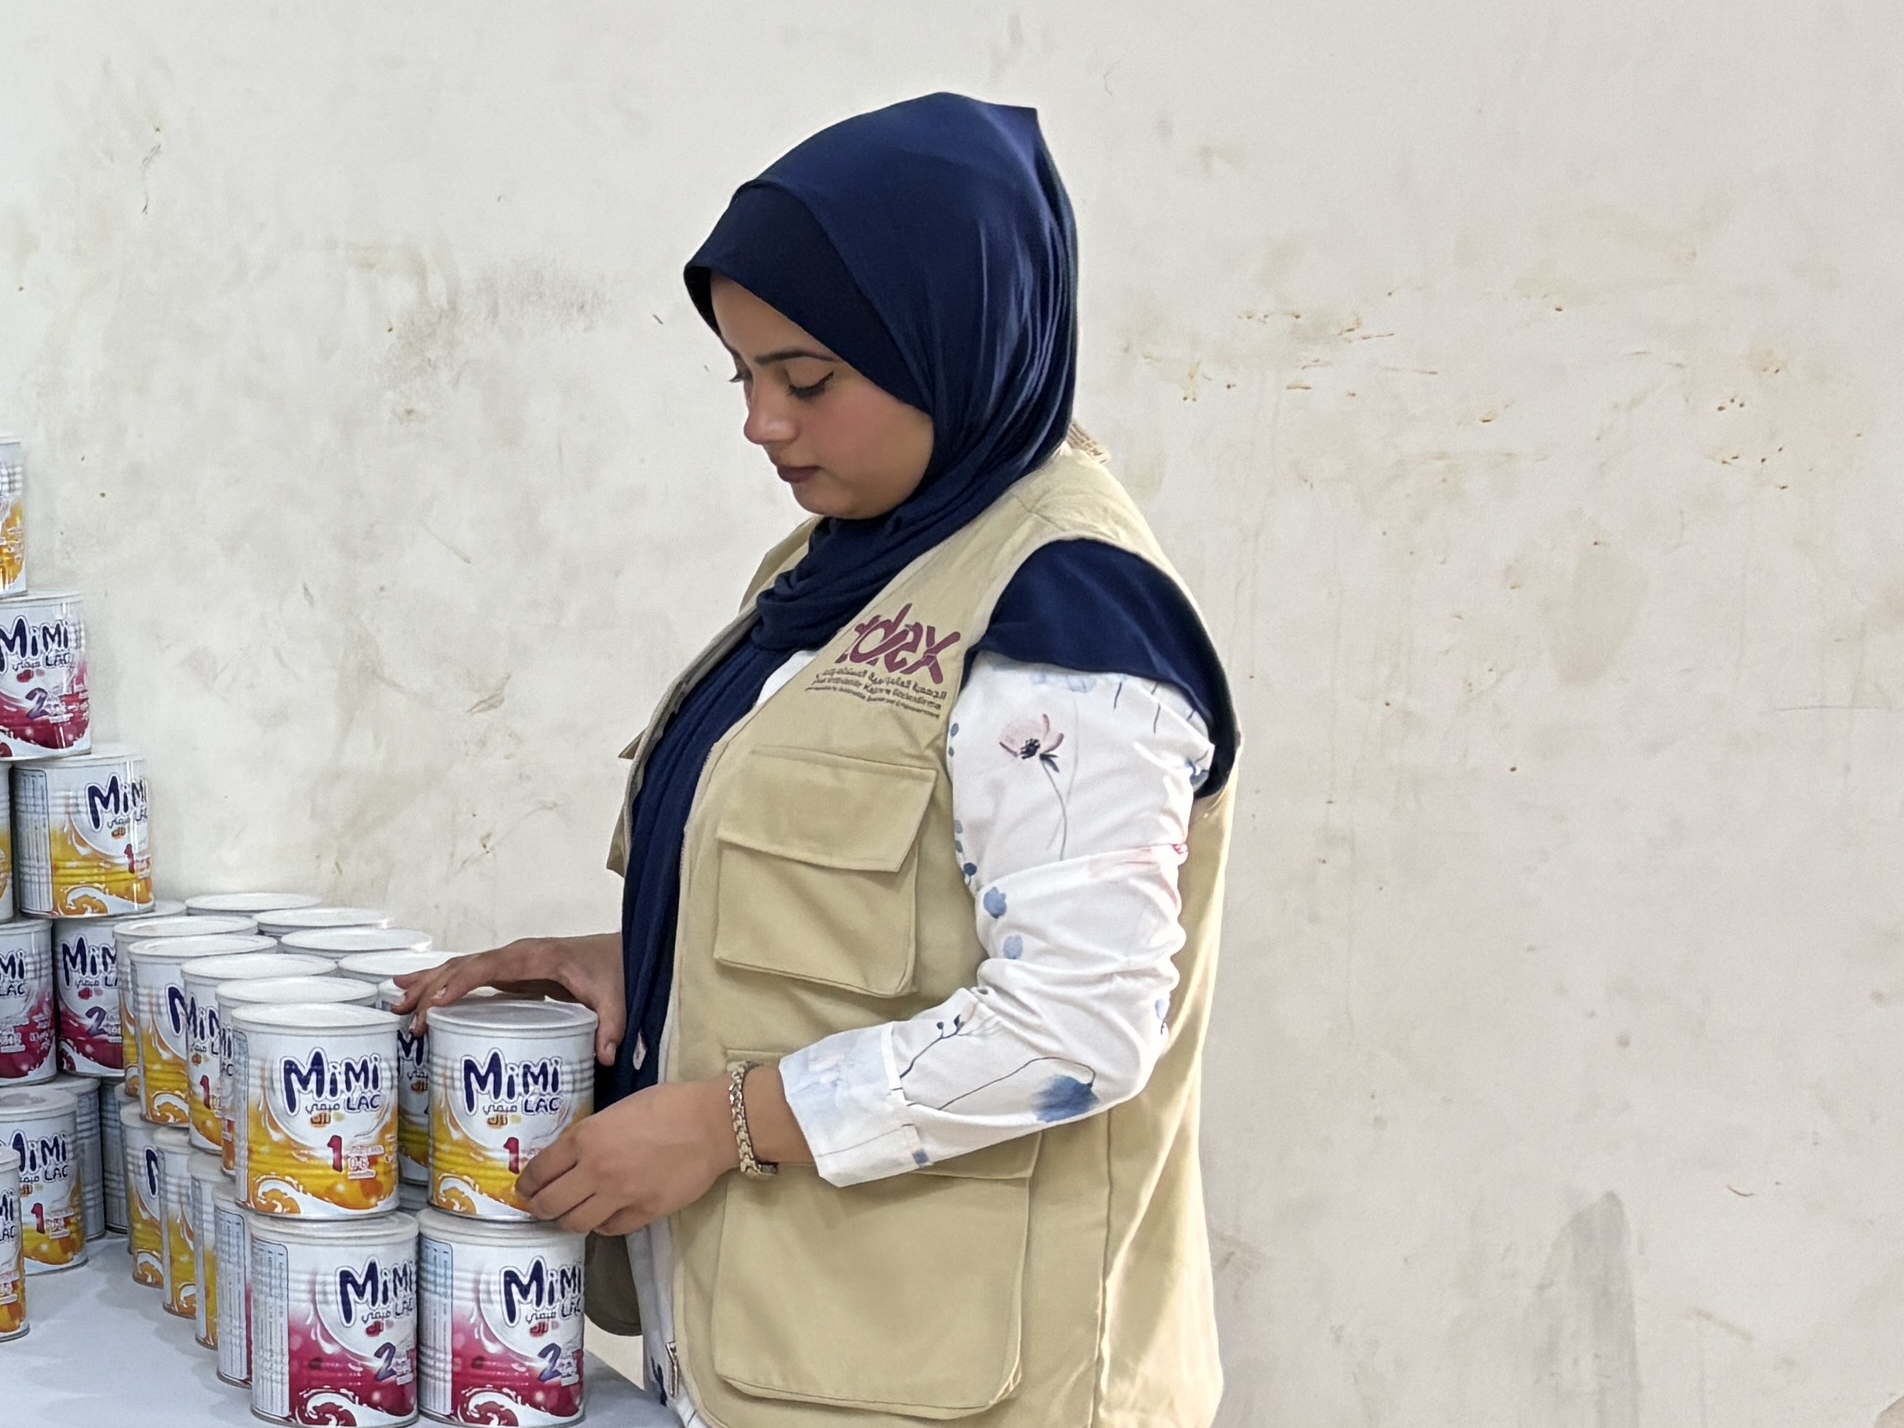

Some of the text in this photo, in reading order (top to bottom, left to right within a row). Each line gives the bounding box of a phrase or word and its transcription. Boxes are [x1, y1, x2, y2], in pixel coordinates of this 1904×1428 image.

[346, 1095, 381, 1110] LAC
[524, 1097, 561, 1113] LAC
[327, 1135, 343, 1172] 1
[503, 1137, 520, 1174] 1
[374, 1342, 397, 1382] 2
[538, 1343, 563, 1383] 2
